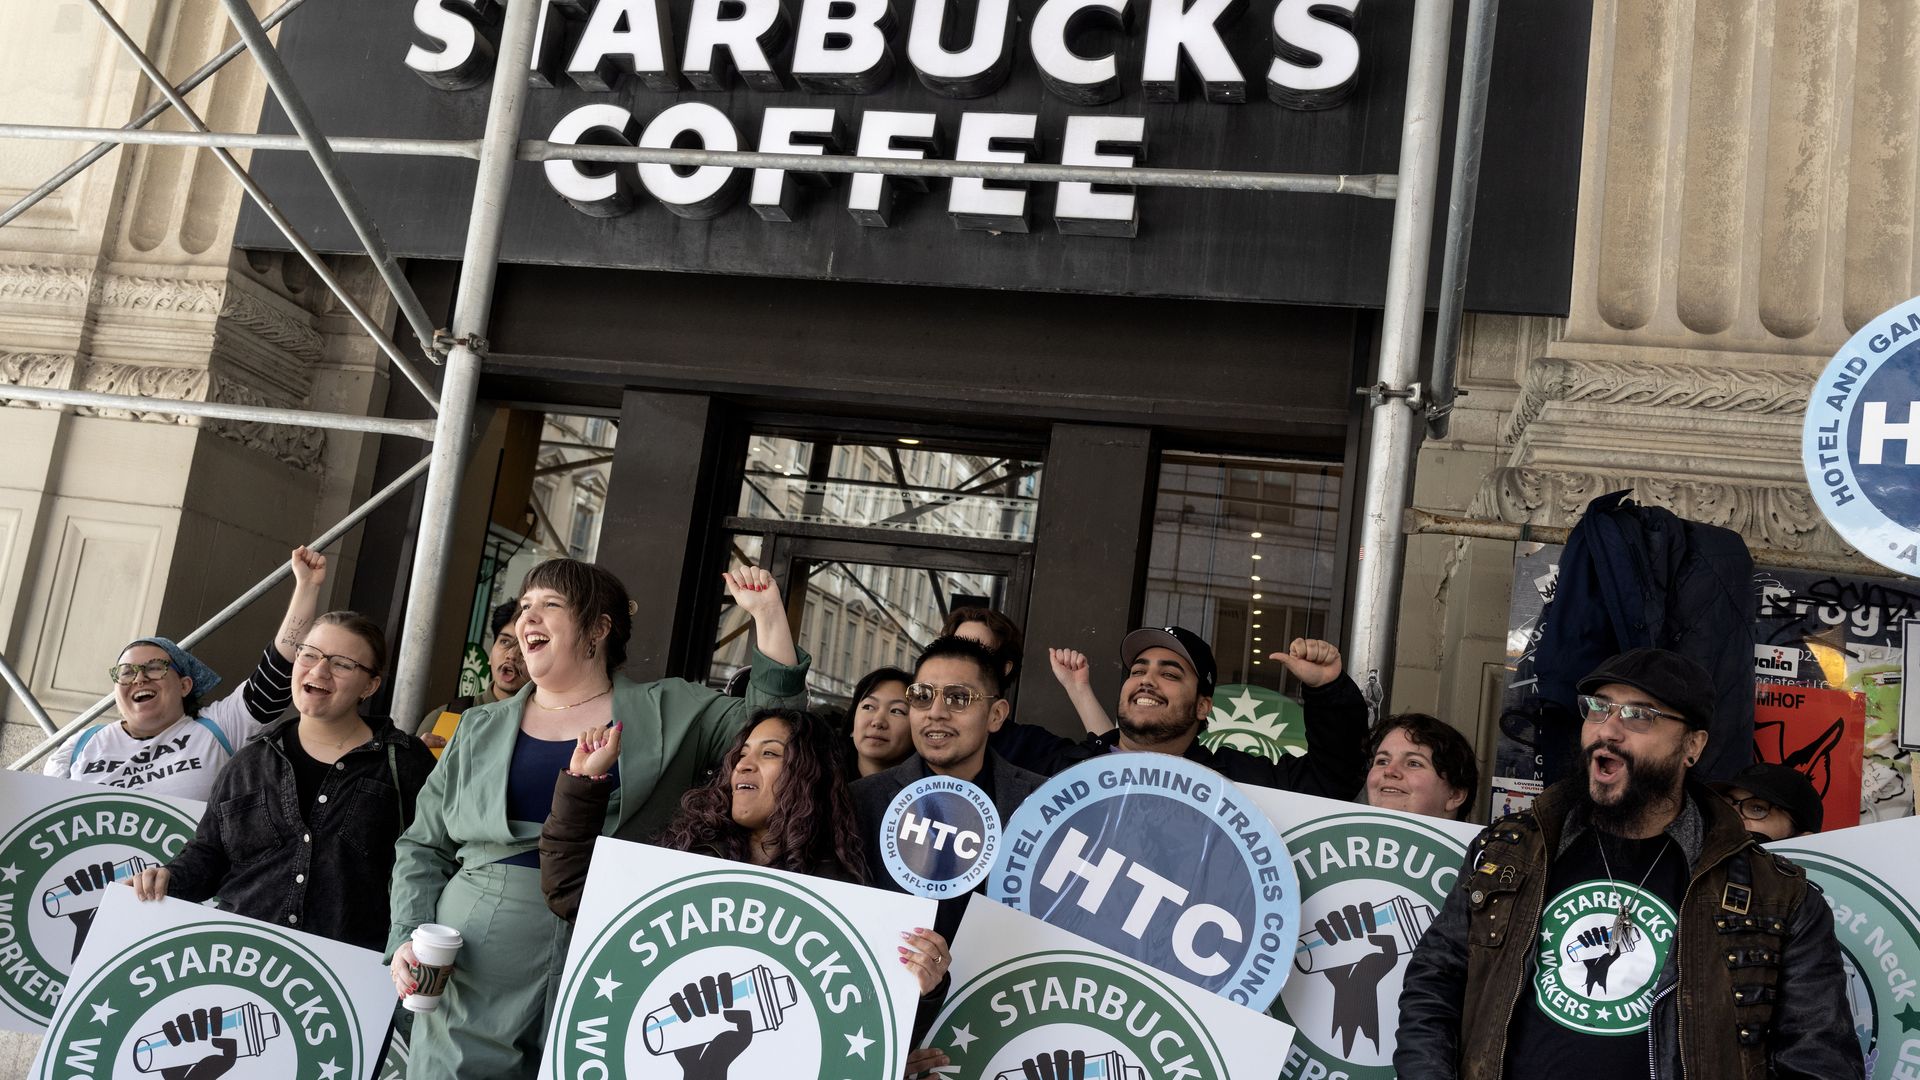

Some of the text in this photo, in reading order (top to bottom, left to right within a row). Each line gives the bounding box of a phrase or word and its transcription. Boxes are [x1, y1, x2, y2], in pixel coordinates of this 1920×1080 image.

[403, 0, 1360, 110] SARBUCKS
[544, 102, 1146, 224] COFFEE
[1825, 356, 1868, 412] AND
[1818, 418, 1855, 507] HOTEL
[122, 763, 154, 776] AND
[130, 734, 191, 764] GAY
[886, 781, 995, 883] HOTEL AND GAMING TRADES COUNCIL
[899, 812, 981, 860] HTC
[1001, 827, 1043, 912] HOTEL
[1039, 779, 1091, 825] AND
[1097, 767, 1213, 803] GAMING
[1217, 797, 1283, 903] TRADES
[902, 872, 948, 892] AFL-CIO
[1039, 826, 1243, 977] HTC
[1553, 891, 1673, 943] STARBUCKS
[129, 943, 337, 1046] STARBUCKS
[628, 897, 862, 1014] STARBUCKS
[1540, 949, 1591, 1020] WORKERS
[1864, 926, 1917, 1002] Neck
